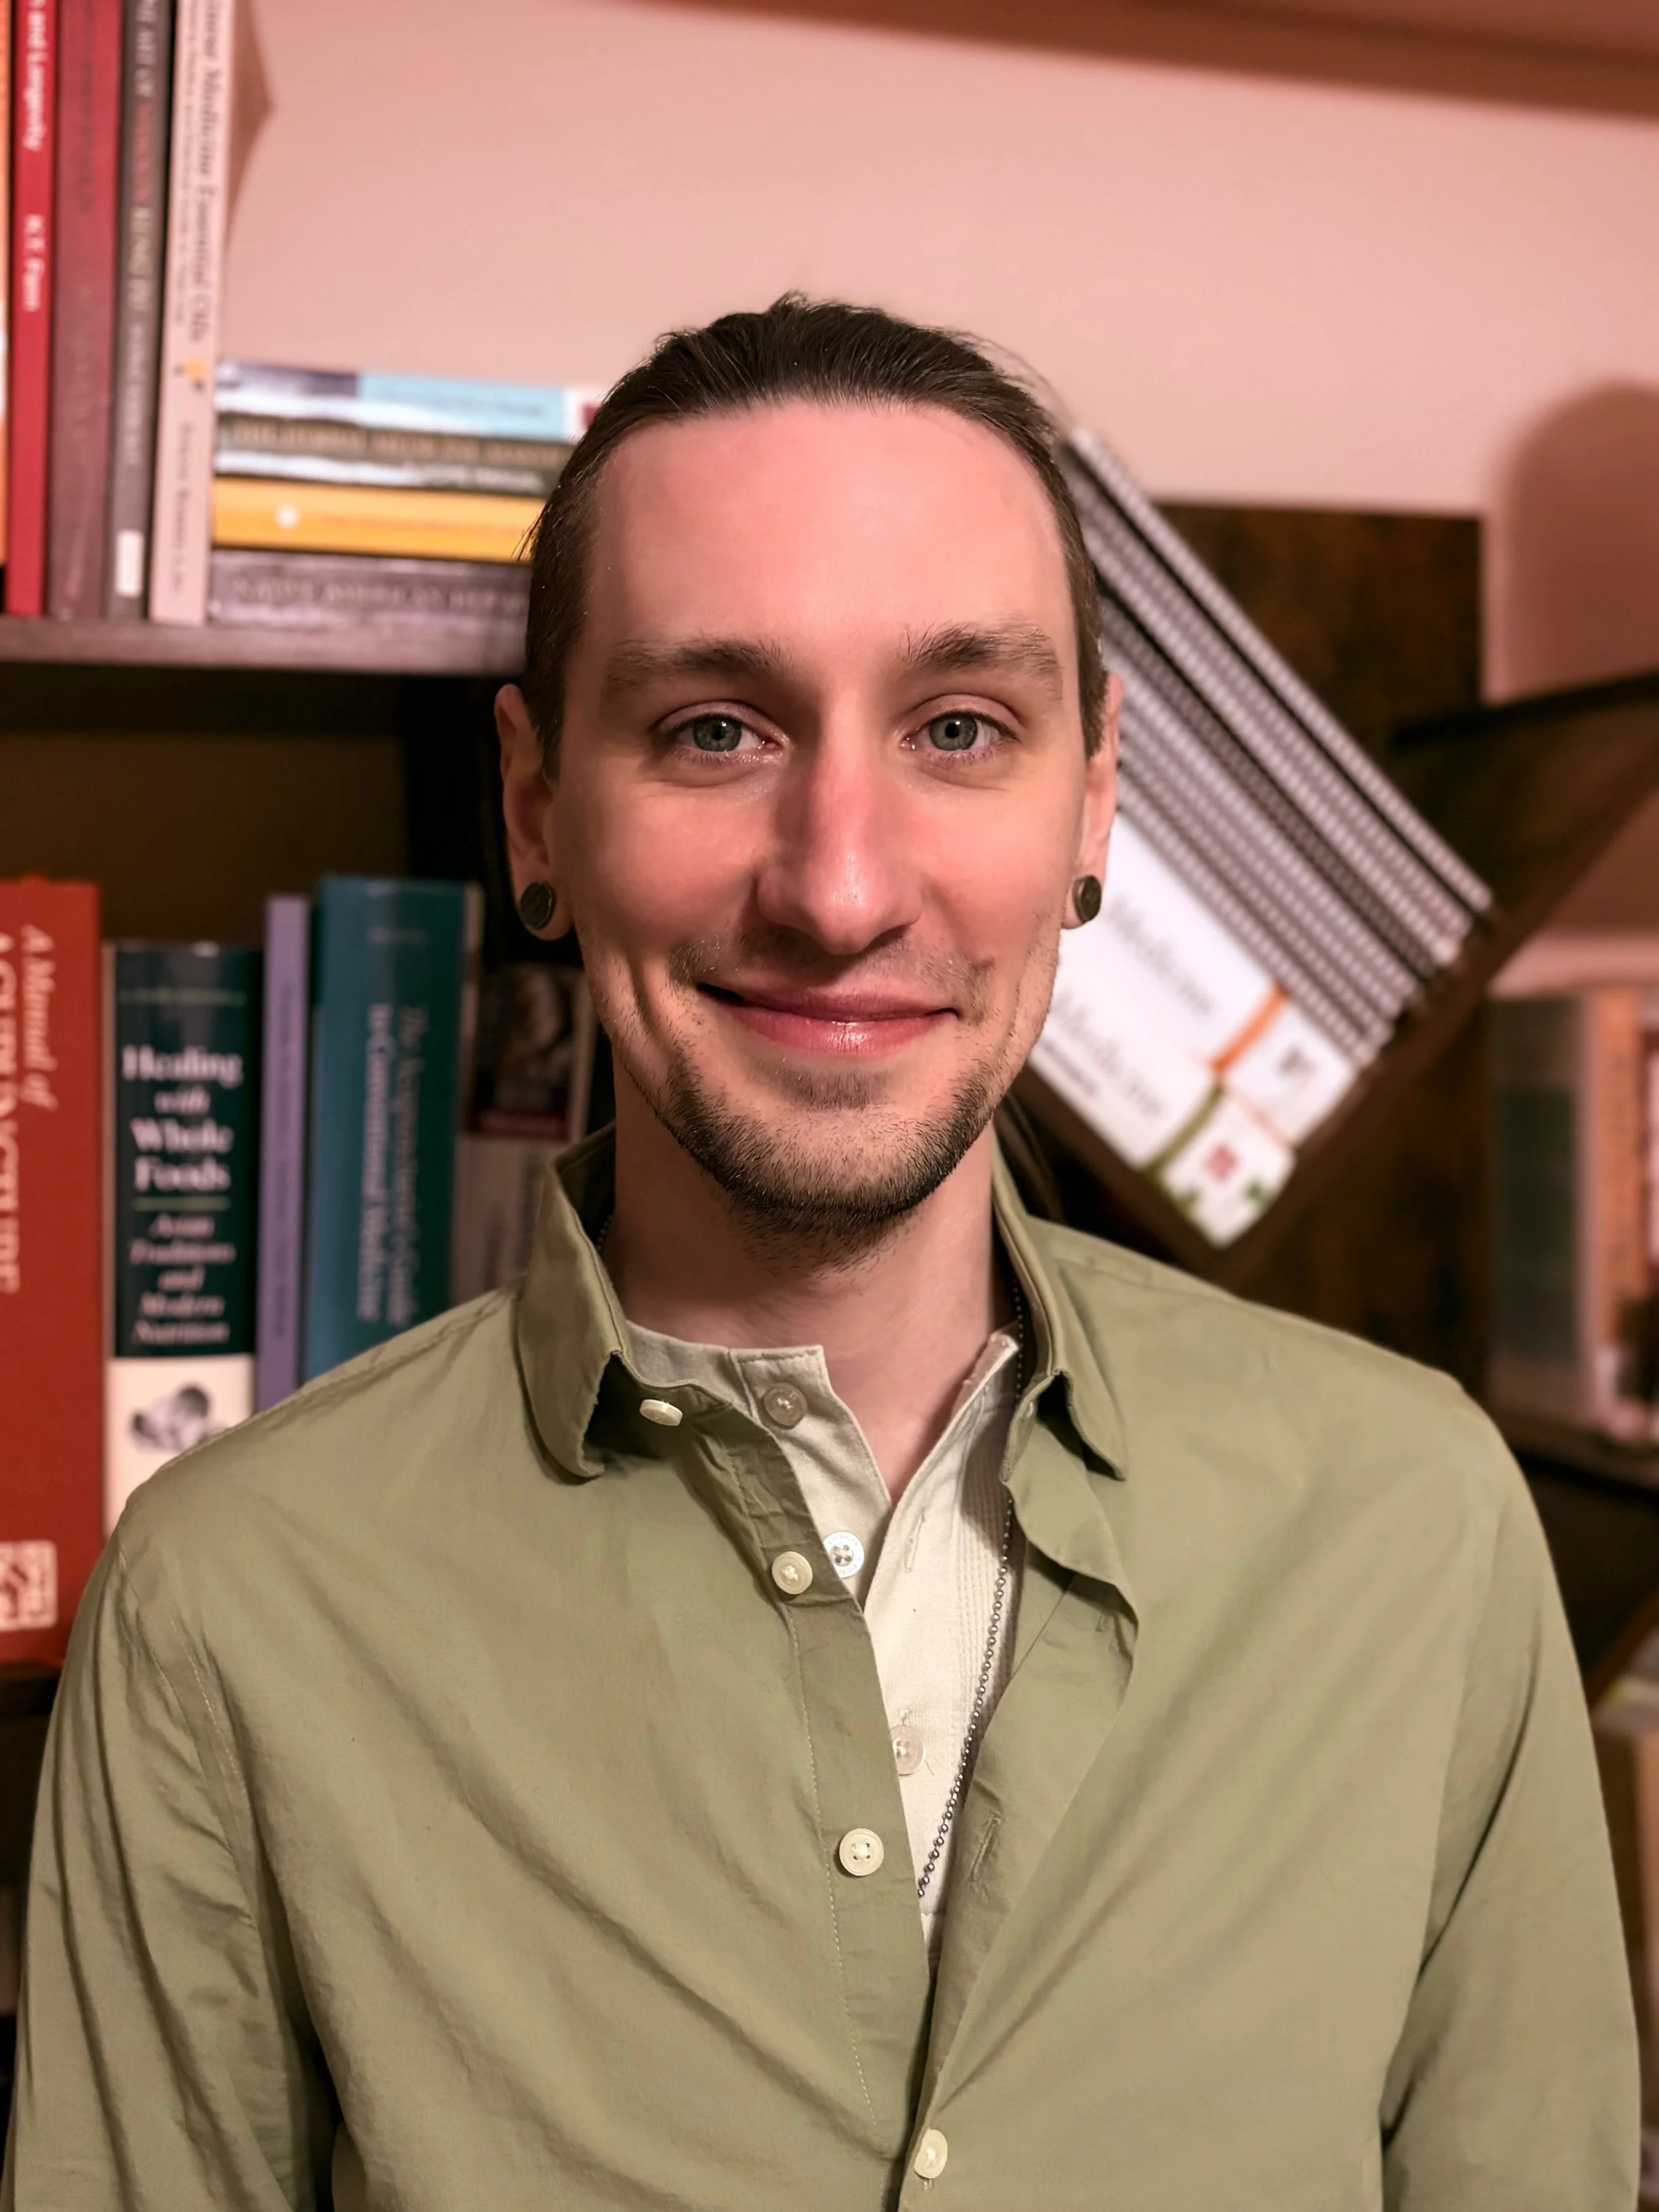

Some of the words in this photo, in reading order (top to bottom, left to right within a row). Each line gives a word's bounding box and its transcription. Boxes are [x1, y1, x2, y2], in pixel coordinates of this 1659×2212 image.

[27, 11, 46, 48] and
[22, 51, 47, 152] Longevity
[20, 923, 54, 953] A
[23, 953, 58, 1071] Manual
[121, 1044, 243, 1087] Healing
[19, 1071, 59, 1112] of
[155, 1085, 210, 1115] with
[131, 1118, 234, 1154] Whole
[135, 1155, 231, 1191] Foods
